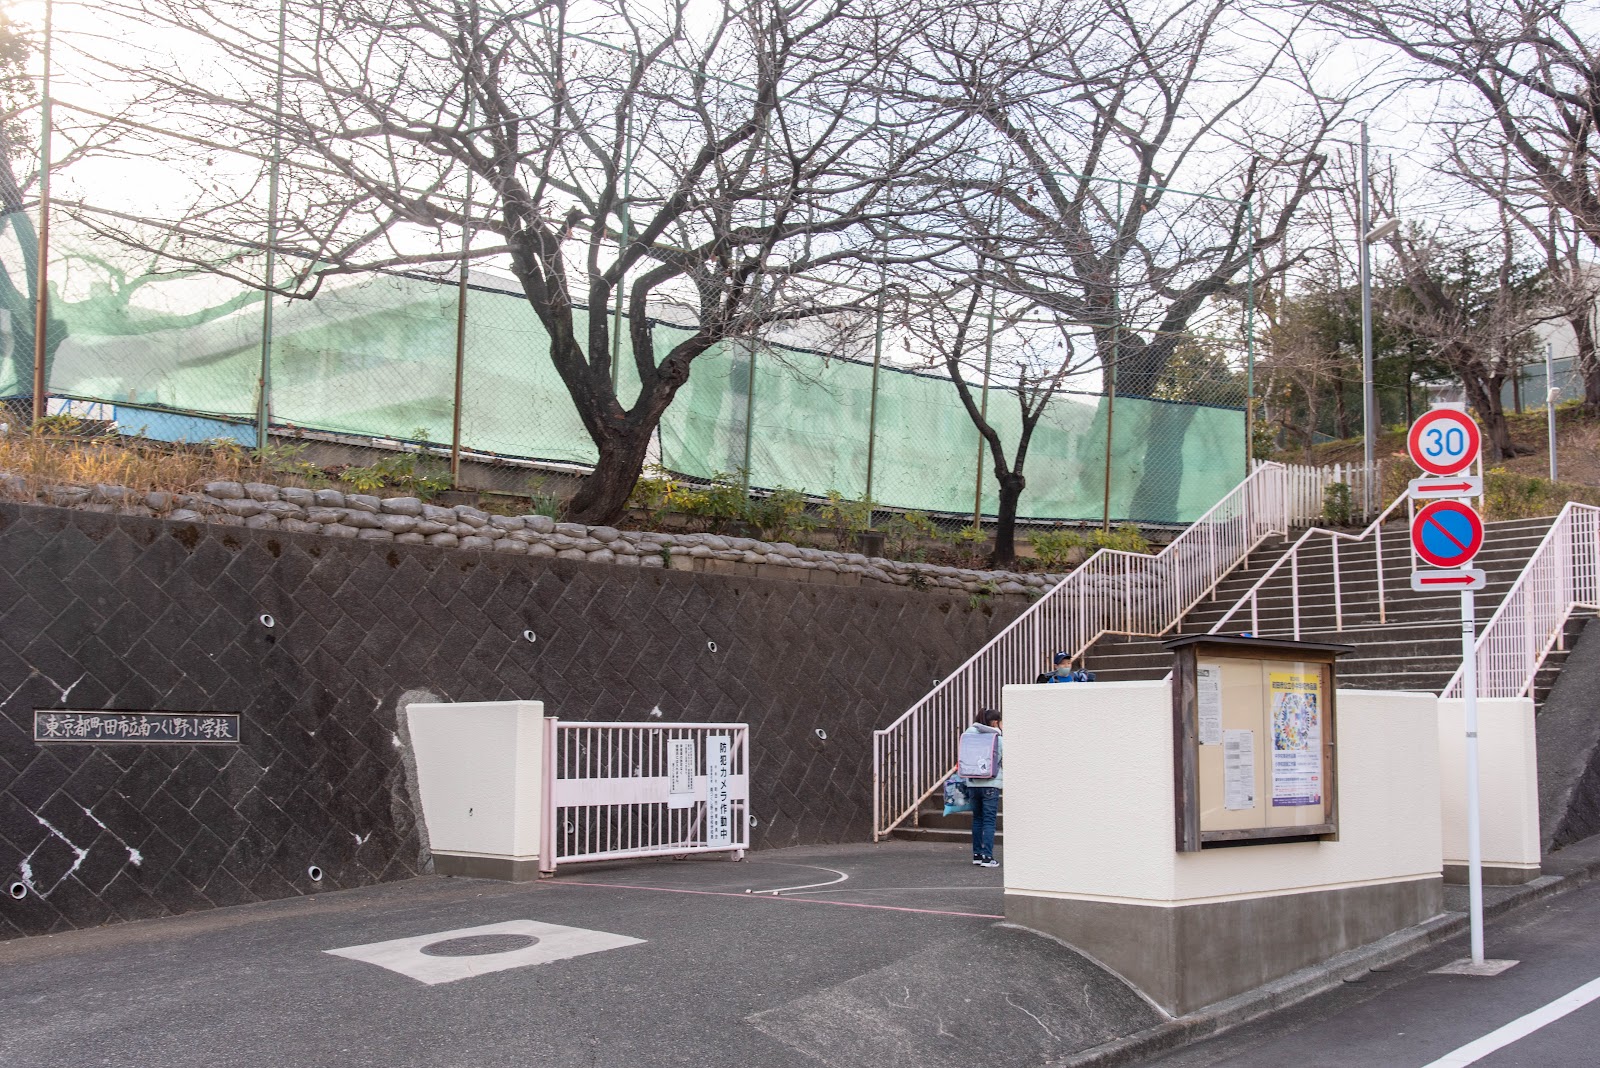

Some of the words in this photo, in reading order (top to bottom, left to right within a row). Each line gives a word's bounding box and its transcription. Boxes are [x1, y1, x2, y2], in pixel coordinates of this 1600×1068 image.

[1426, 427, 1464, 457] 30
[42, 713, 234, 739] 東京都町田市立南つくし野小学校
[719, 742, 728, 840] 防犯カメラ作動中
